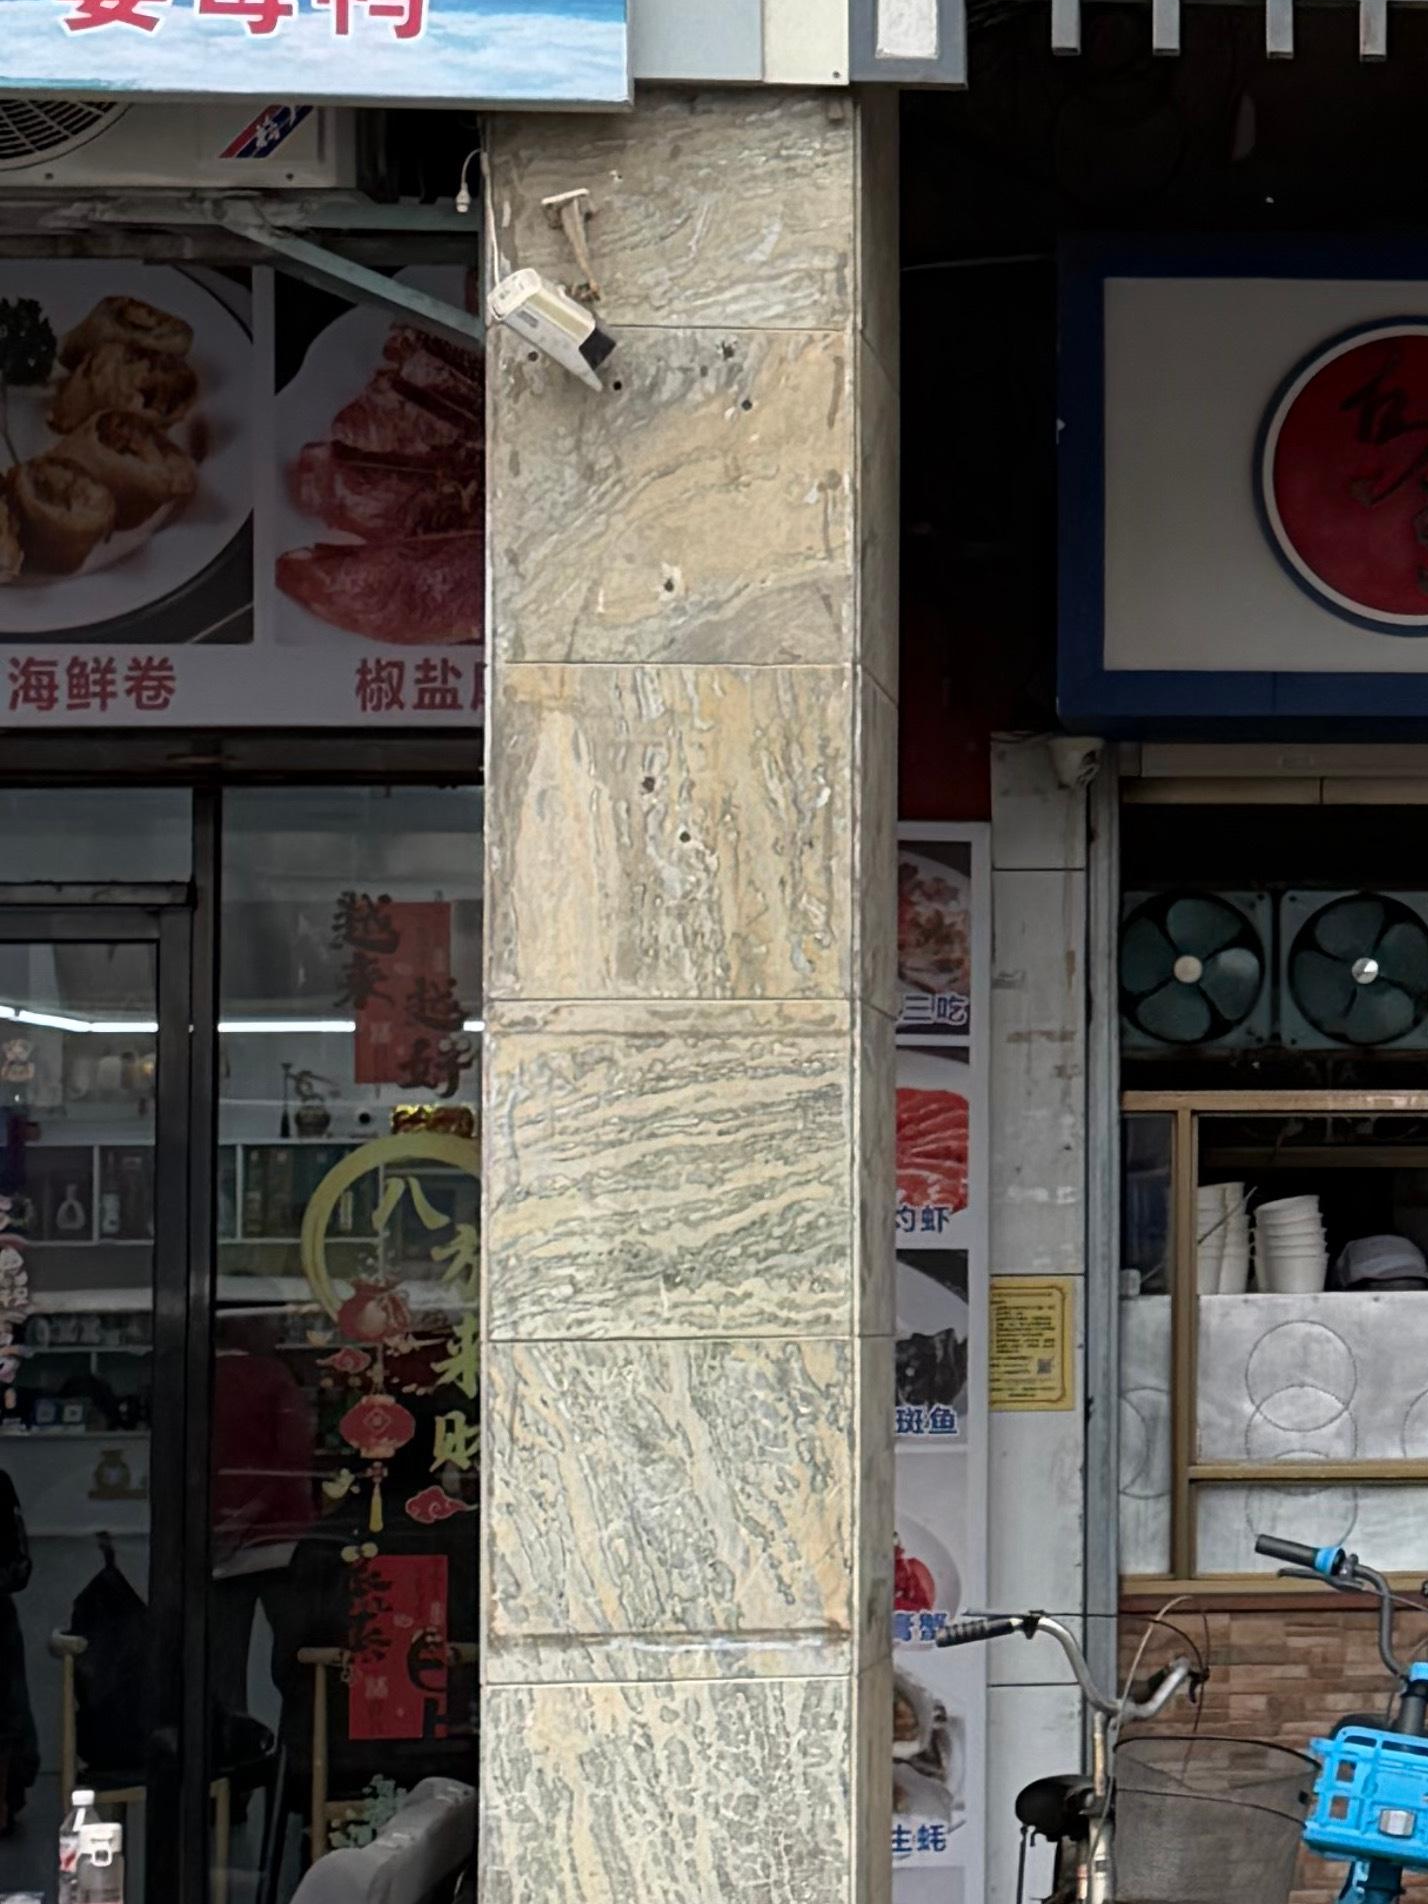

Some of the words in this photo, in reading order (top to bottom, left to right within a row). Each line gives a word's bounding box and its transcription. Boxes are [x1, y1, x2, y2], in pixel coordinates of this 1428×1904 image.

[9, 656, 176, 712] 海鲜卷
[356, 657, 486, 712] 椒盐
[903, 995, 966, 1023] 三吃
